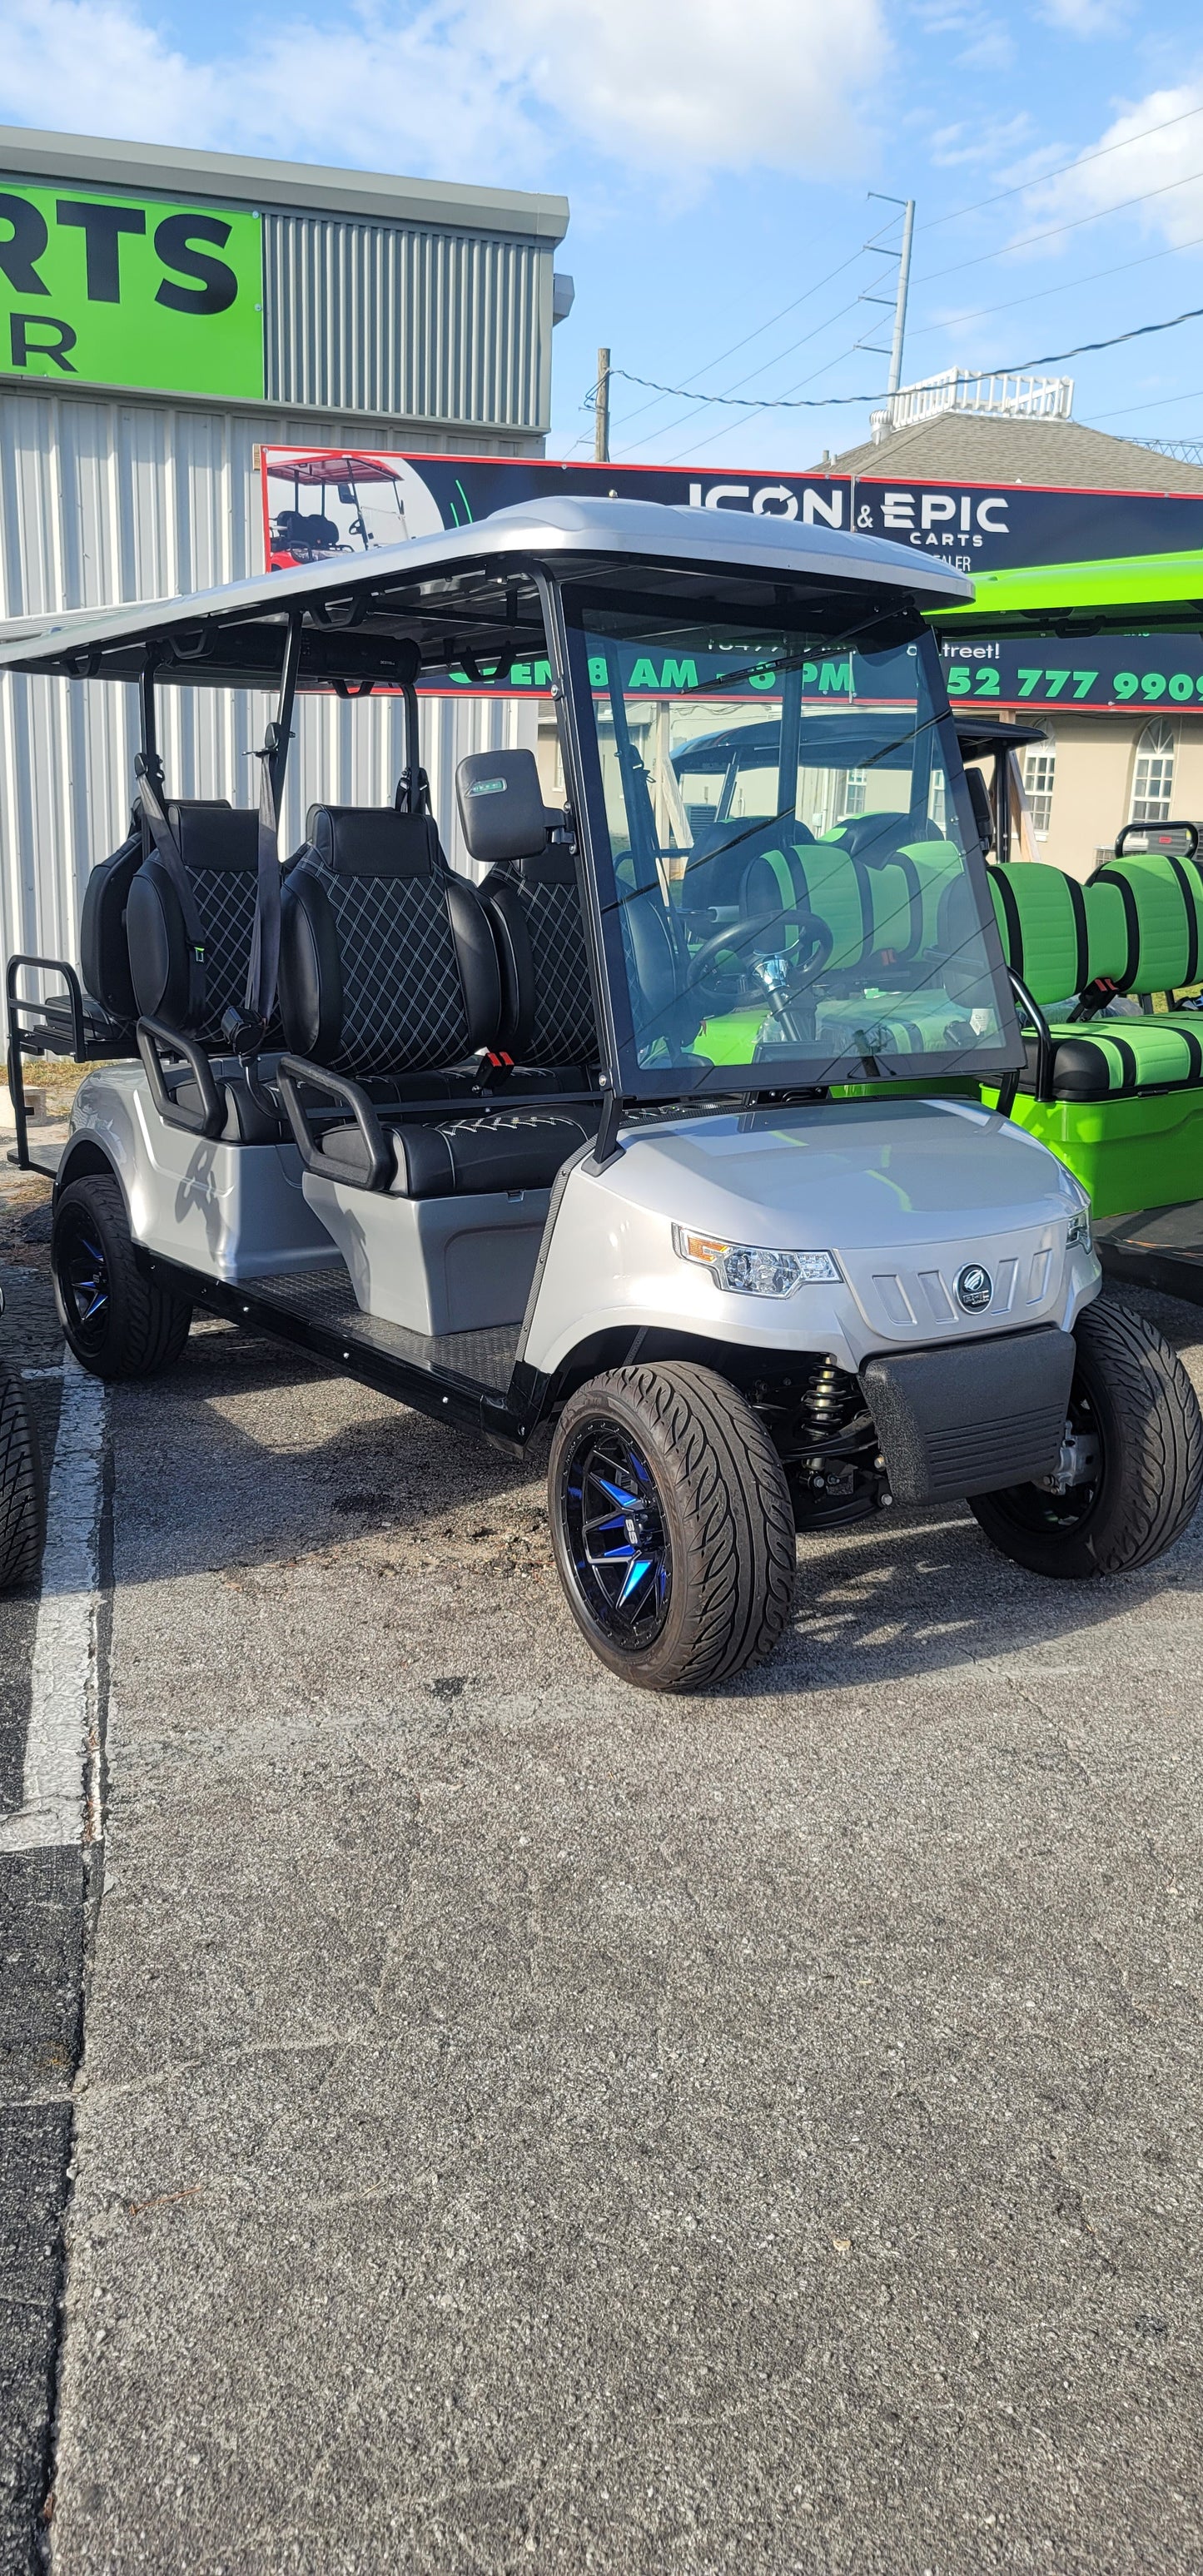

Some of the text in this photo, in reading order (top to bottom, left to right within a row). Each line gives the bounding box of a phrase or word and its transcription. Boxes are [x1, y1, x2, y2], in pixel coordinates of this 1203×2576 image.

[9, 312, 79, 373] R
[857, 505, 874, 528] &
[880, 492, 1010, 533] EPIC
[909, 532, 983, 547] CARTS
[938, 642, 1000, 659] treet!
[628, 659, 698, 688] AM
[1017, 669, 1099, 699] 777
